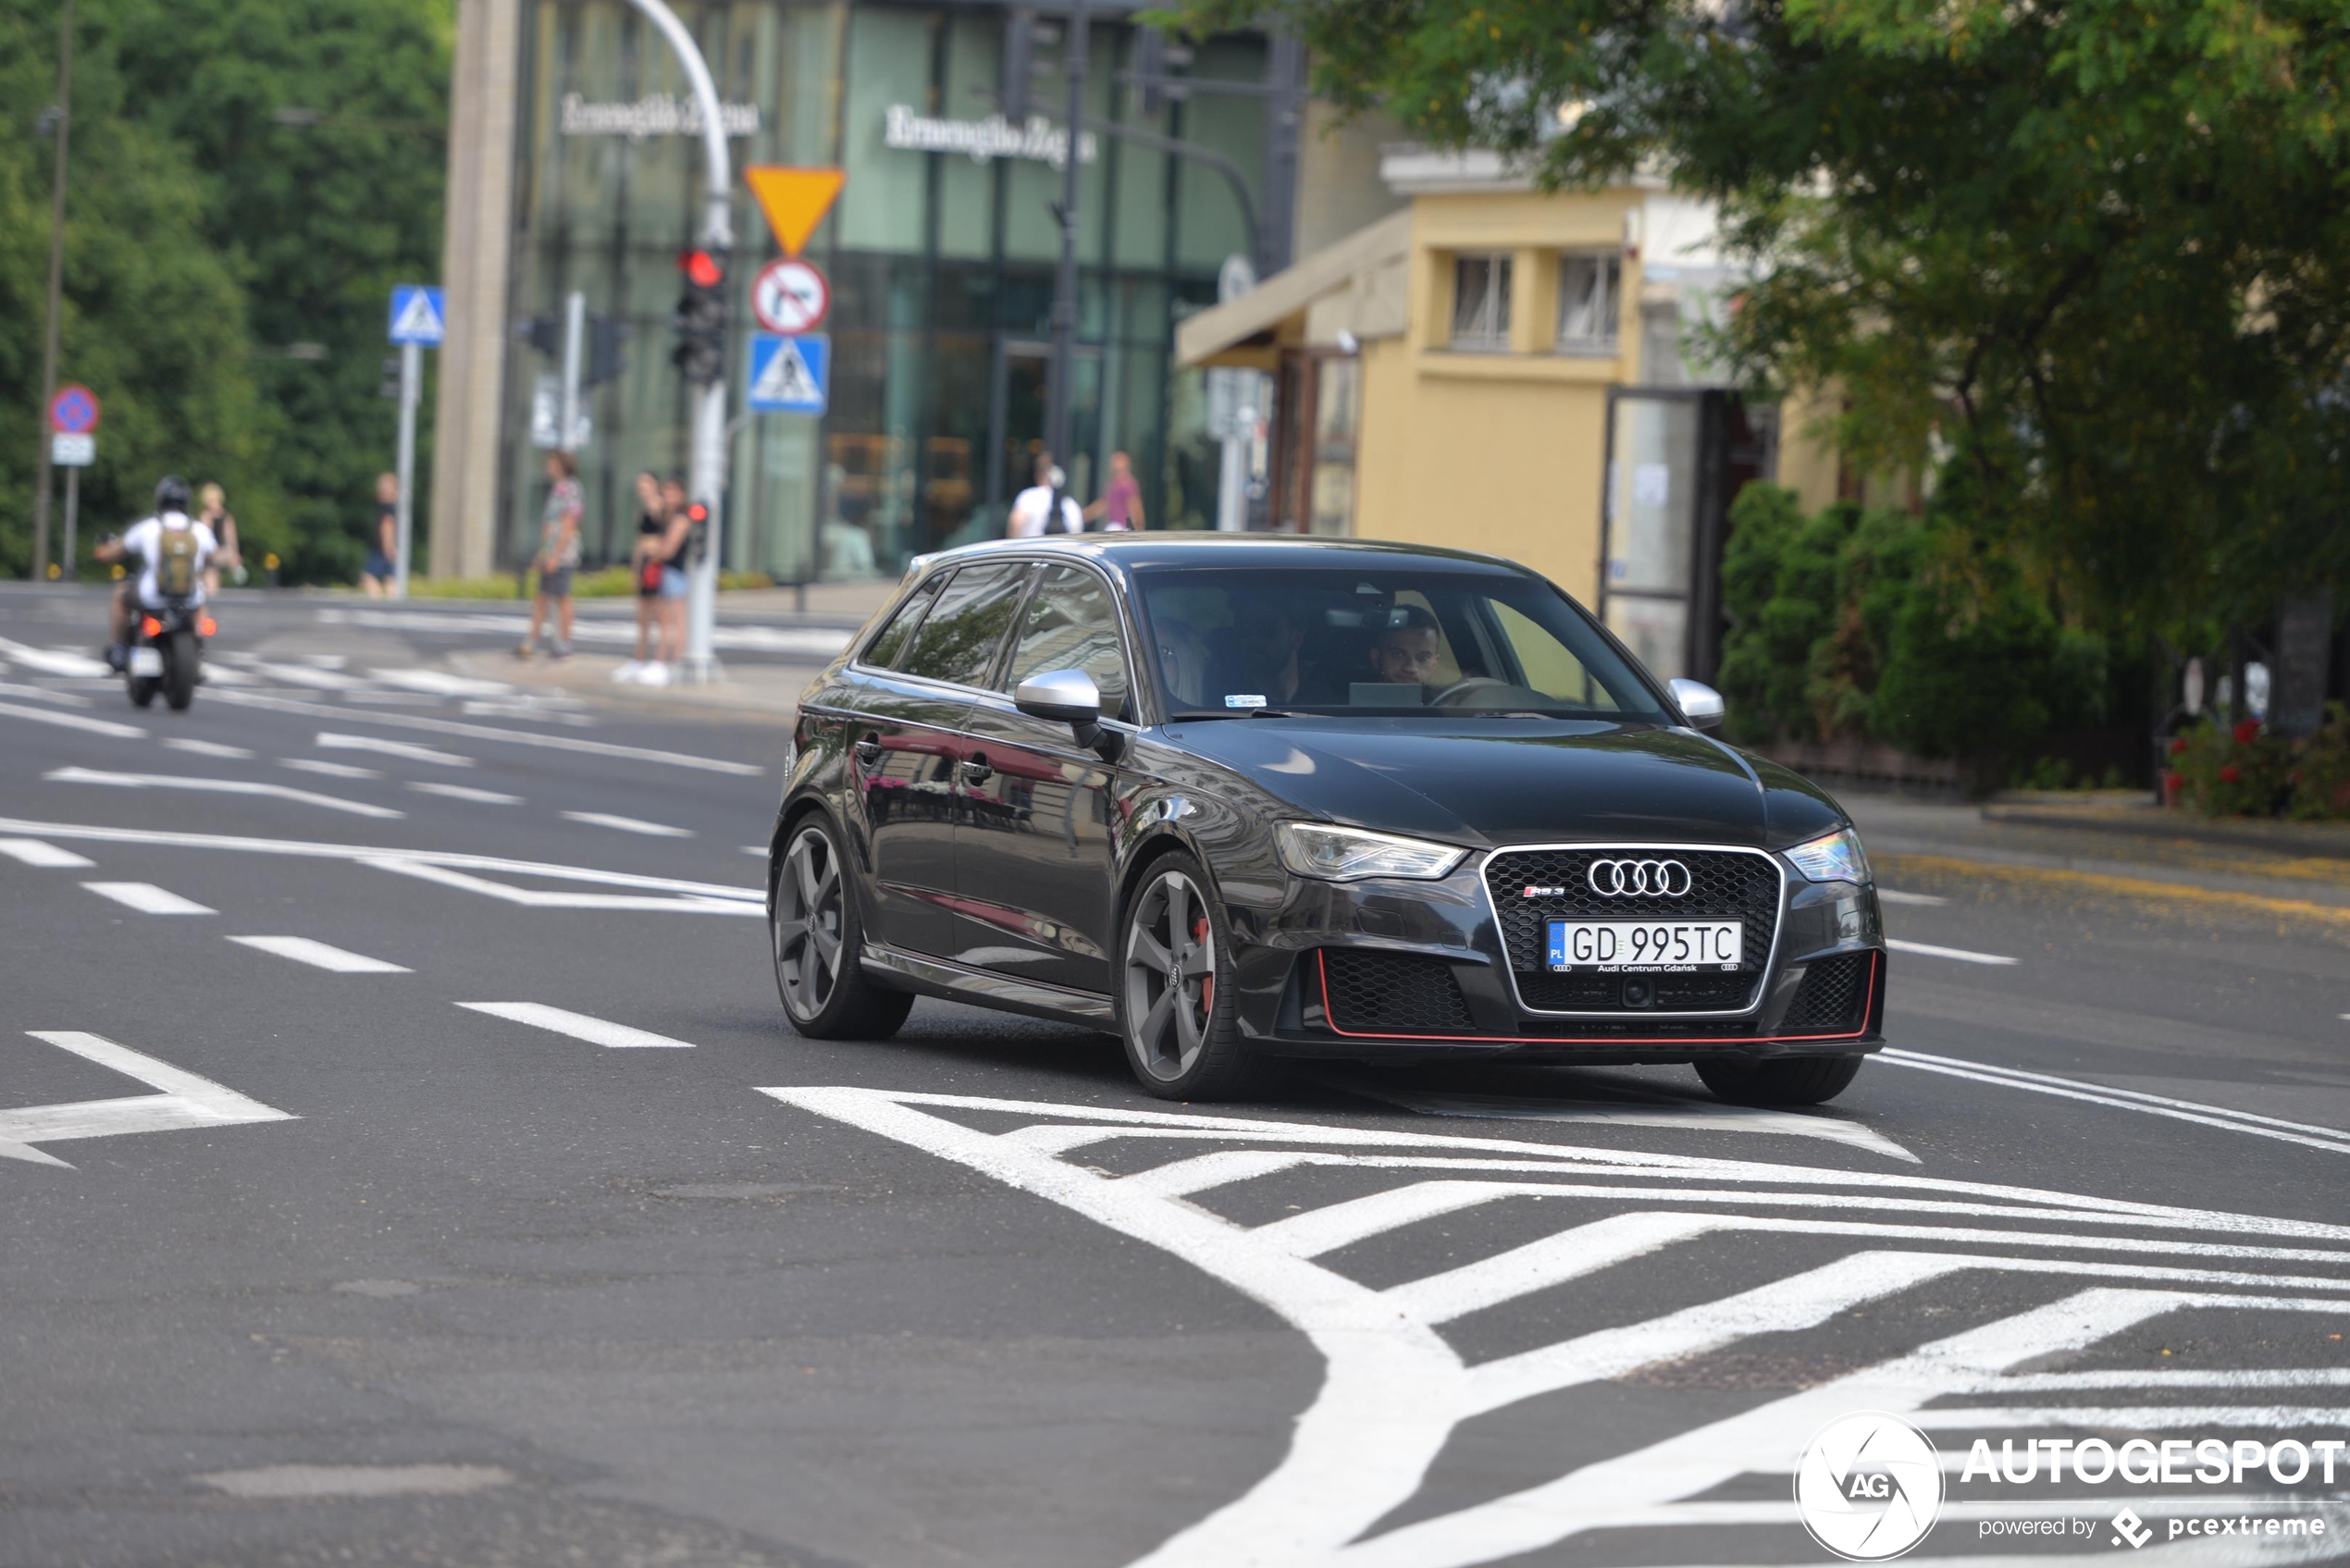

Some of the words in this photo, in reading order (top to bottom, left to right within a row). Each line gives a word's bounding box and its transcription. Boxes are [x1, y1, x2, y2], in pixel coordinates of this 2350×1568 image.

[1574, 927, 1616, 961] GD
[1631, 926, 1733, 961] 995TC
[1551, 949, 1563, 958] PL
[1664, 964, 1697, 972] Gdańsk
